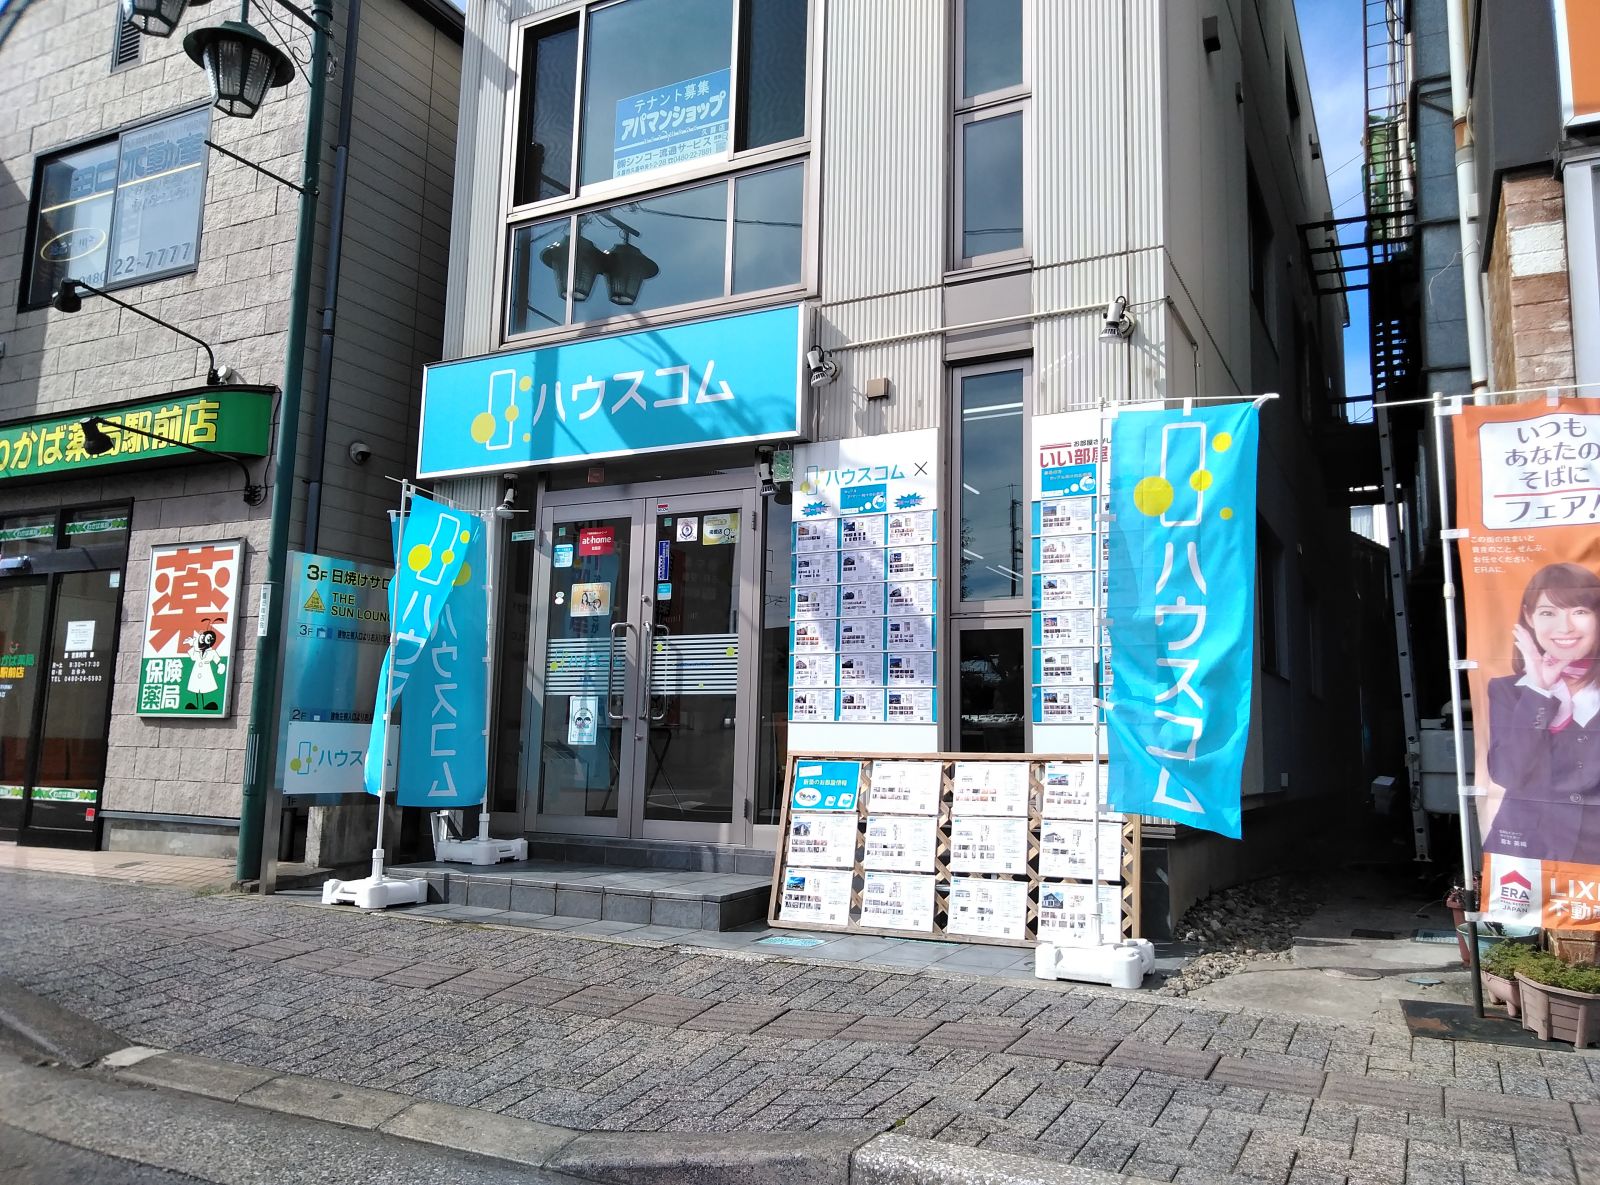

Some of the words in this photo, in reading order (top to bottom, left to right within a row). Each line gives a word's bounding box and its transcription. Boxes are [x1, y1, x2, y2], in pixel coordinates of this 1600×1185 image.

[635, 80, 710, 113] テナント募集
[621, 90, 727, 141] アパマンショップ
[533, 360, 735, 426] ハウスコム
[1517, 418, 1587, 443] いつも
[1505, 441, 1600, 467] あなたの
[826, 464, 906, 487] ハウスコム
[1519, 465, 1590, 490] そばに
[149, 546, 234, 655] 薬
[332, 592, 355, 605] THE
[331, 606, 354, 618] SUN
[357, 609, 391, 622] LOUN
[299, 624, 313, 636] 3F
[145, 659, 183, 683] 保険
[1145, 541, 1207, 814] ハウスコム
[141, 684, 181, 711] 薬局
[1501, 887, 1530, 900] ERA
[1503, 905, 1528, 913] JAPAN
